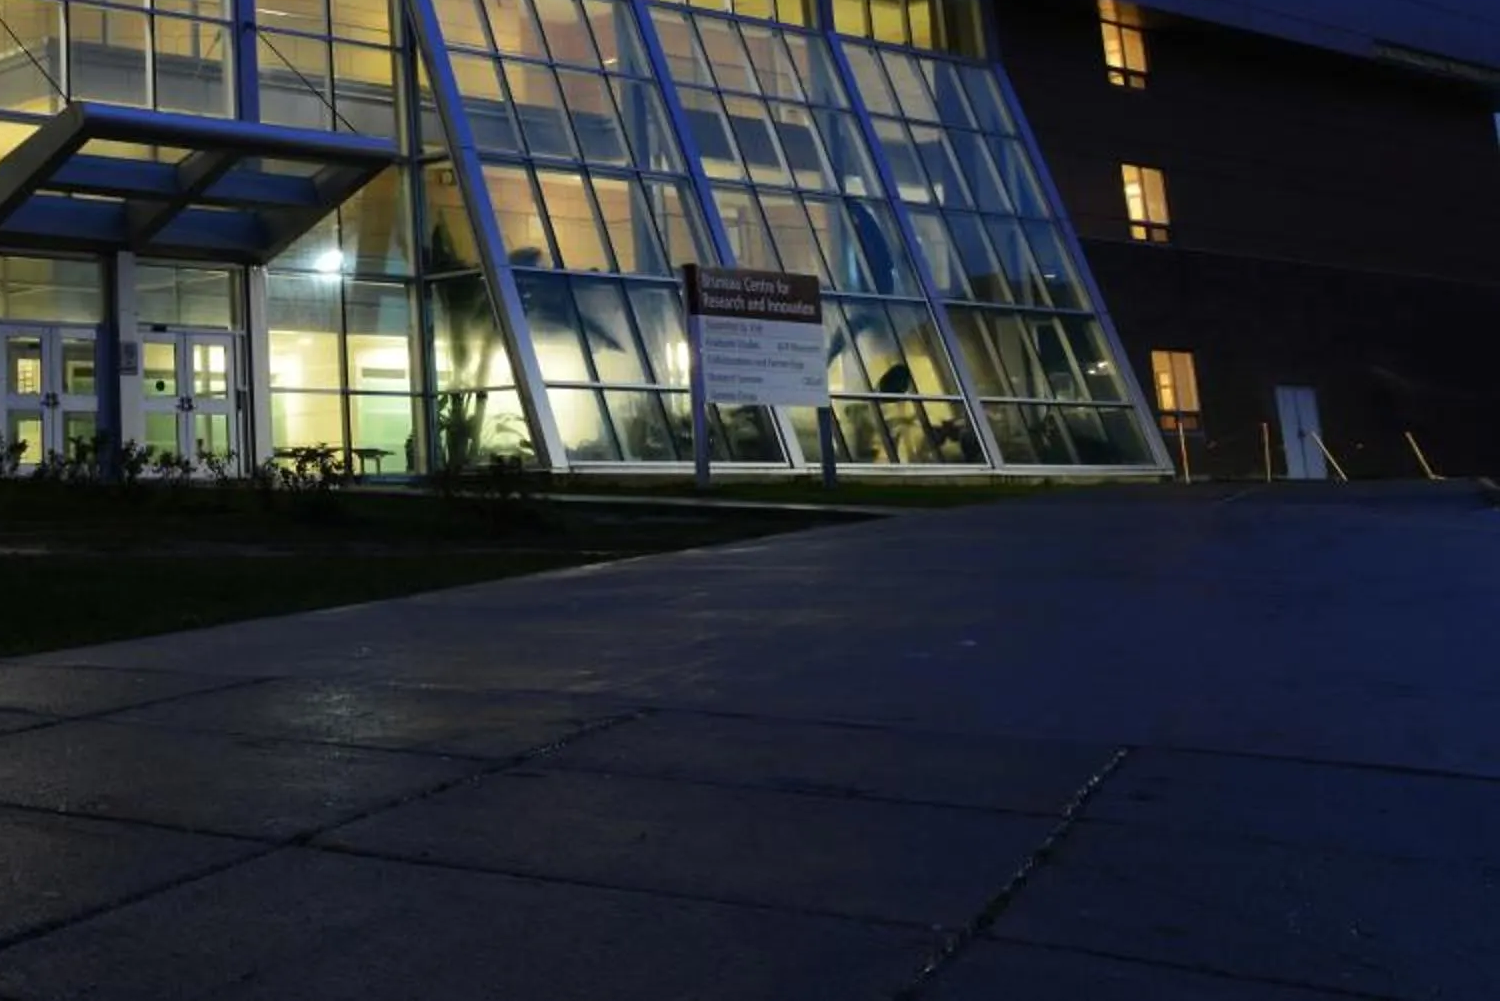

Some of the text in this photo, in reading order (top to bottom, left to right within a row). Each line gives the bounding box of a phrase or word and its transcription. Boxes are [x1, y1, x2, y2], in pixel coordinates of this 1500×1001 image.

[744, 277, 775, 293] Centre
[776, 278, 790, 294] for
[702, 293, 815, 315] Research and Innovation
